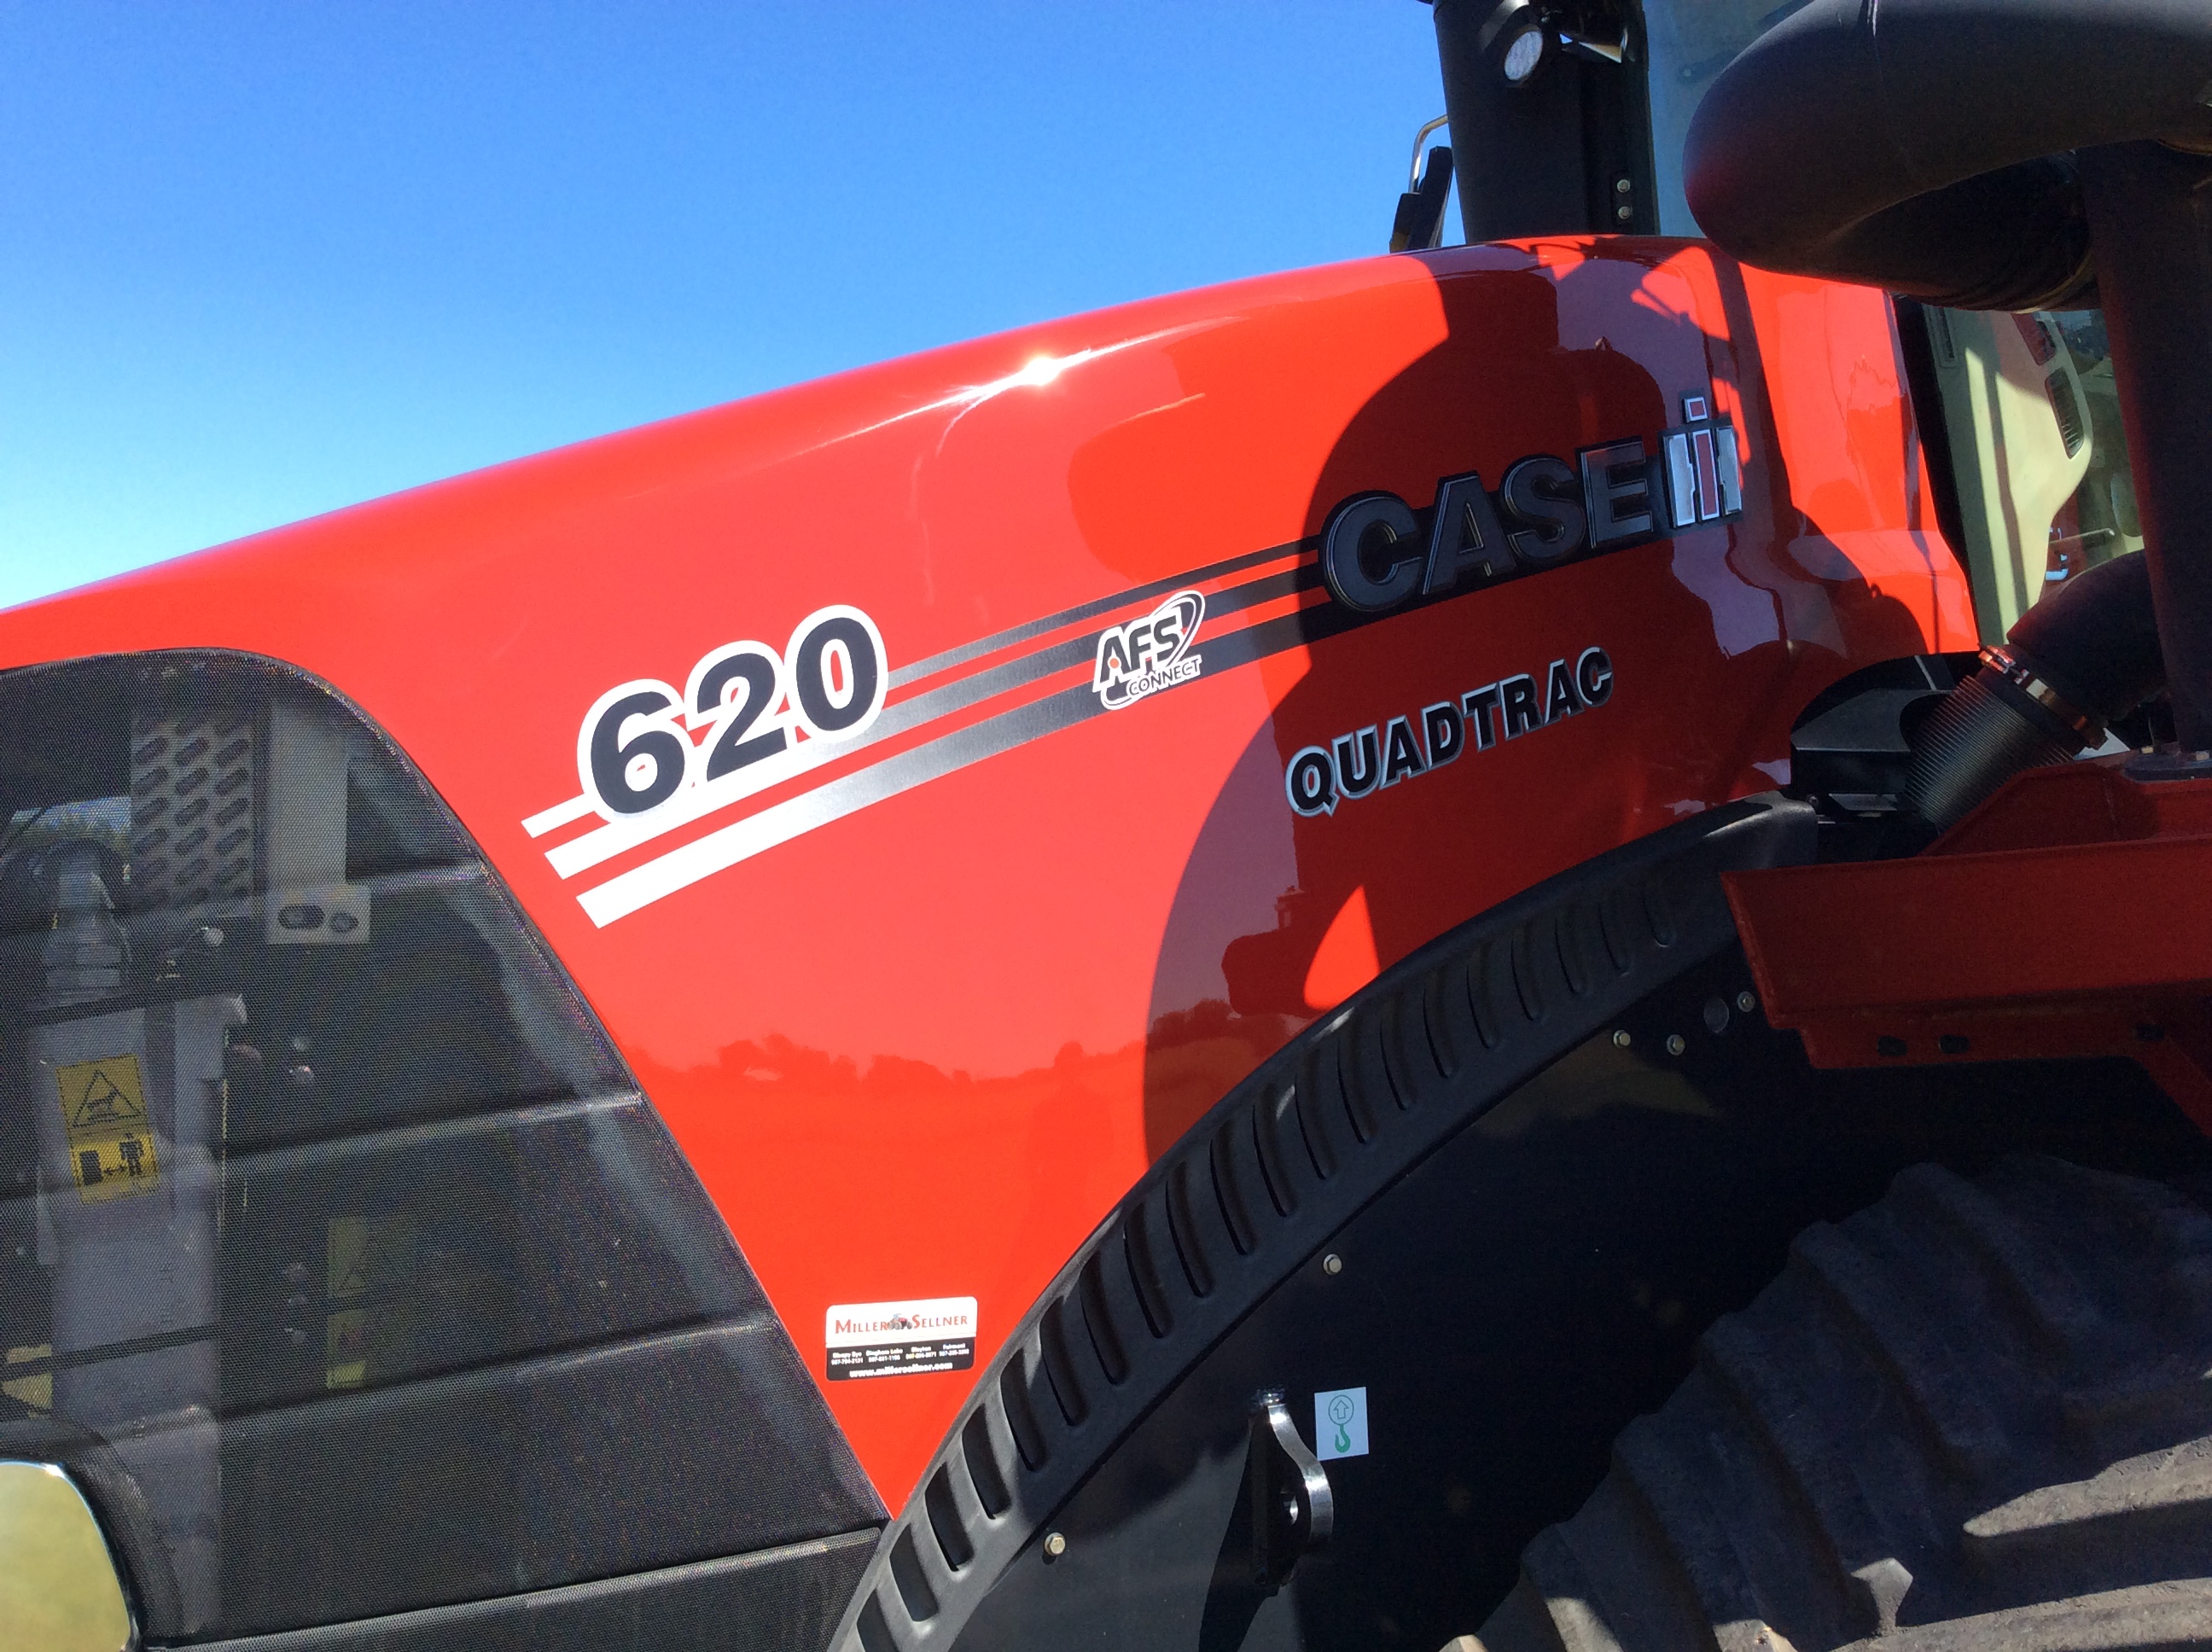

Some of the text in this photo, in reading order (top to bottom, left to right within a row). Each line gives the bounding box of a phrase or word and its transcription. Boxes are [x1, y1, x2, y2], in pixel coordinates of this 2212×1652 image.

[1320, 439, 1654, 613] CASE
[1098, 614, 1181, 686] AFS
[1128, 658, 1200, 696] CONNECT
[587, 614, 881, 817] 620
[1284, 646, 1614, 816] QUADTRAC
[835, 1314, 968, 1334] MILLER SELLNER
